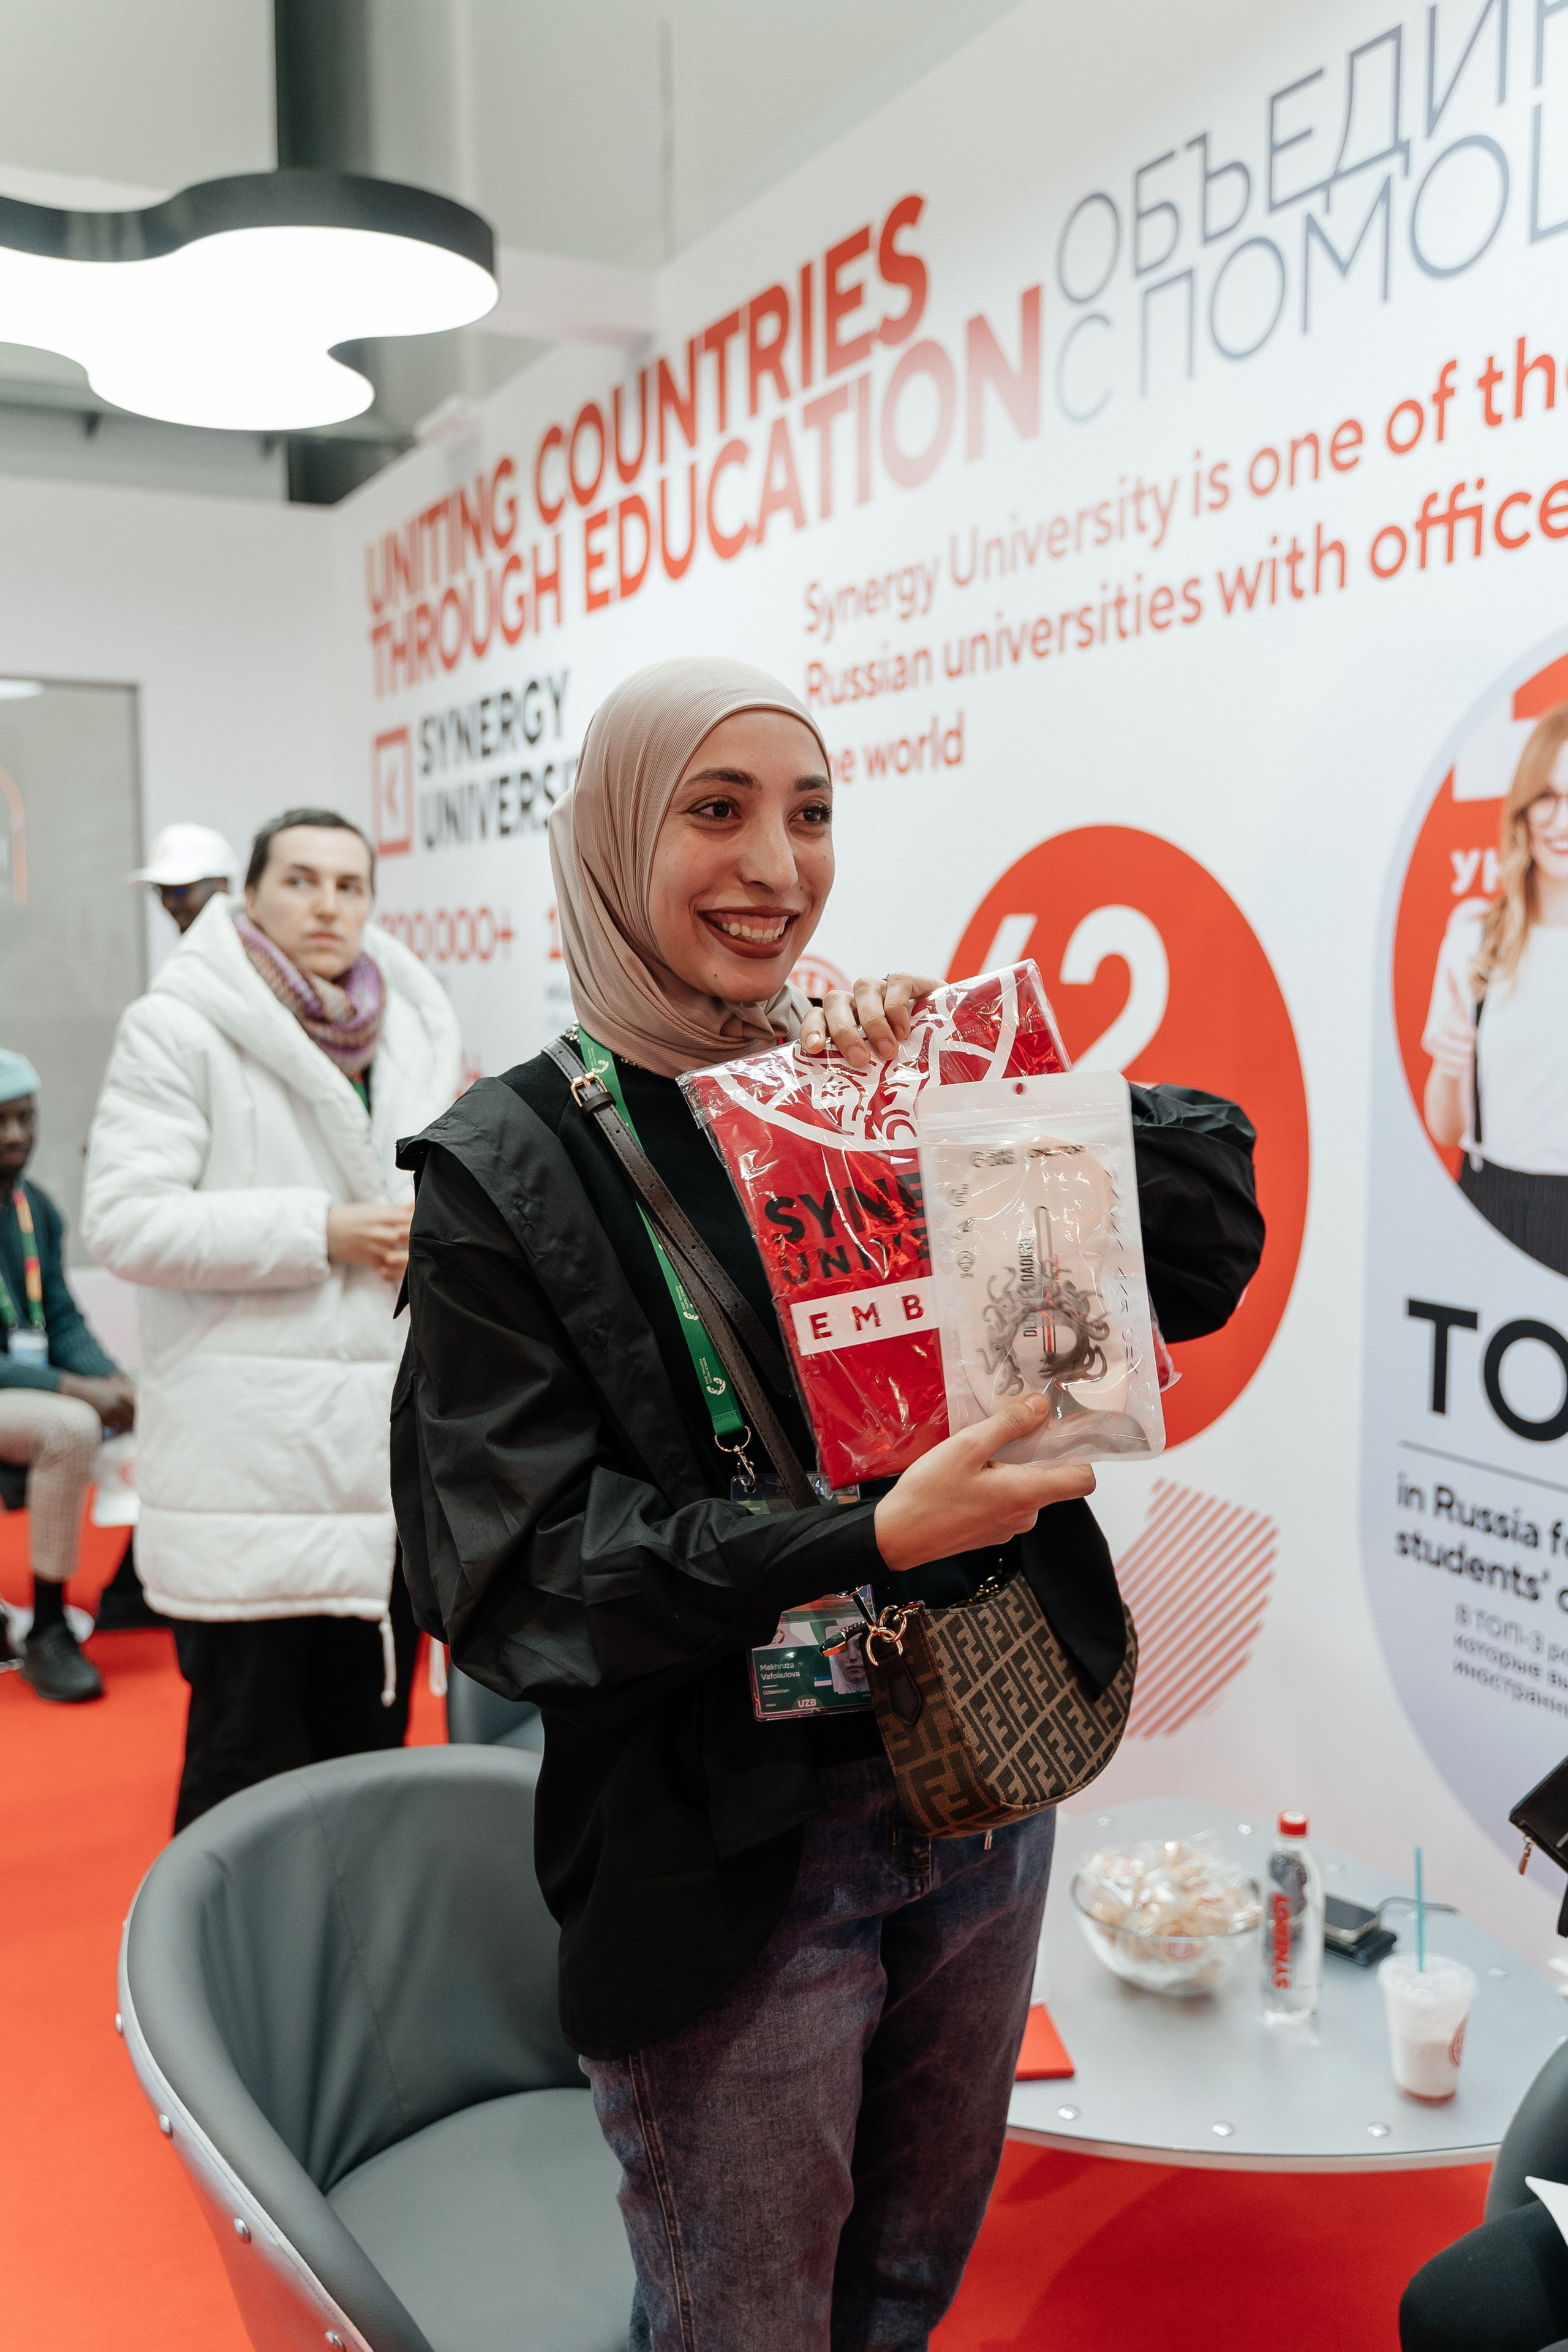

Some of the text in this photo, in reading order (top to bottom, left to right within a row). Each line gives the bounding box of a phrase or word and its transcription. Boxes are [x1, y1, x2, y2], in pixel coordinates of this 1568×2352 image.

[366, 194, 929, 614] UNITING COUNTRIES
[371, 282, 1042, 700] THROUGH EDUCATION
[805, 336, 1568, 644] Synergy University is one of th
[806, 642, 933, 709] Russian
[943, 572, 1202, 678] universities
[1218, 523, 1346, 616] with
[421, 669, 570, 775] SYNERGY
[864, 710, 965, 780] world
[420, 758, 578, 850] UNIVERS
[1396, 1472, 1425, 1512] in
[1433, 1485, 1539, 1548] Russia
[1395, 1532, 1550, 1601] students'
[760, 1662, 794, 1671] Mekhruza
[761, 1671, 801, 1680] Vafokulova
[797, 1698, 817, 1708] UZB
